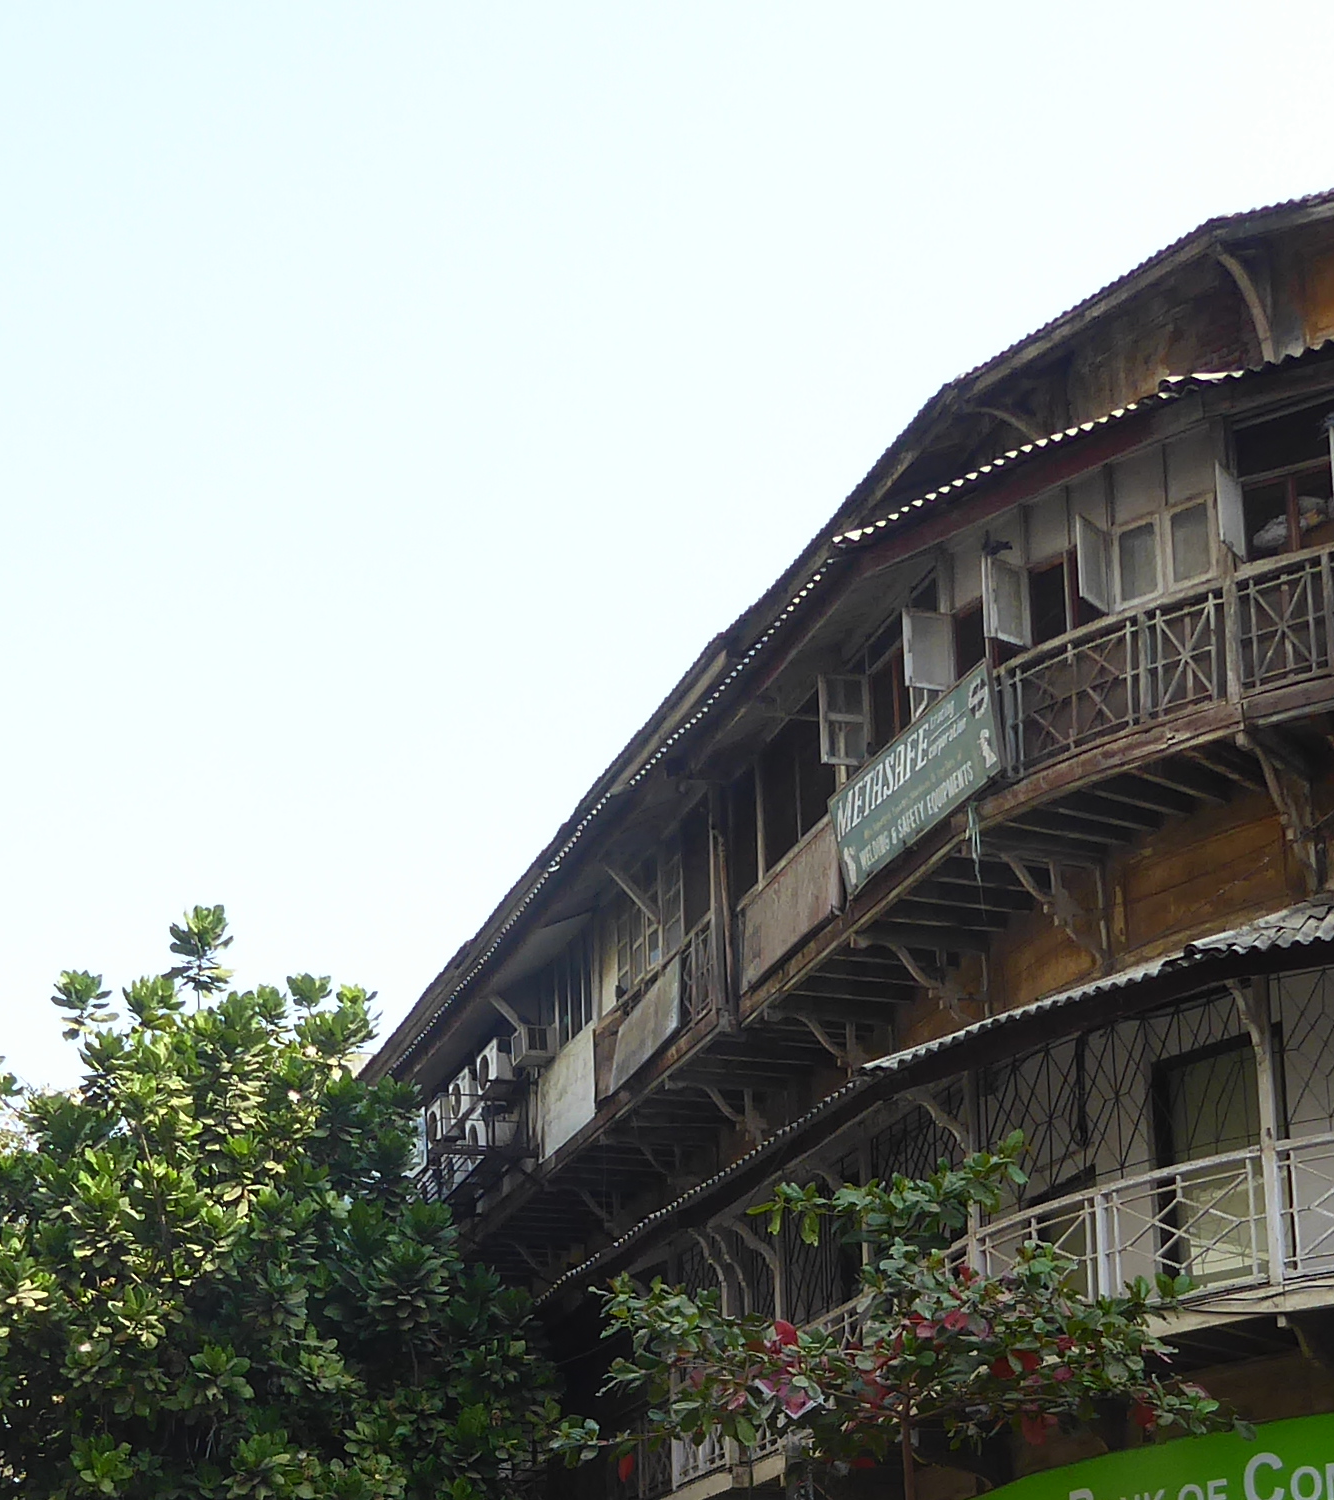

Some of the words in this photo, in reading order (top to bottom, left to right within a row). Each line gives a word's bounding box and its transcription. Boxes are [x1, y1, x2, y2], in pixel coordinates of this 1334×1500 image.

[837, 723, 930, 842] METASAFE
[859, 835, 891, 871] WELDING
[897, 801, 925, 838] SAFETY
[926, 760, 974, 815] EQUIPMENTS
